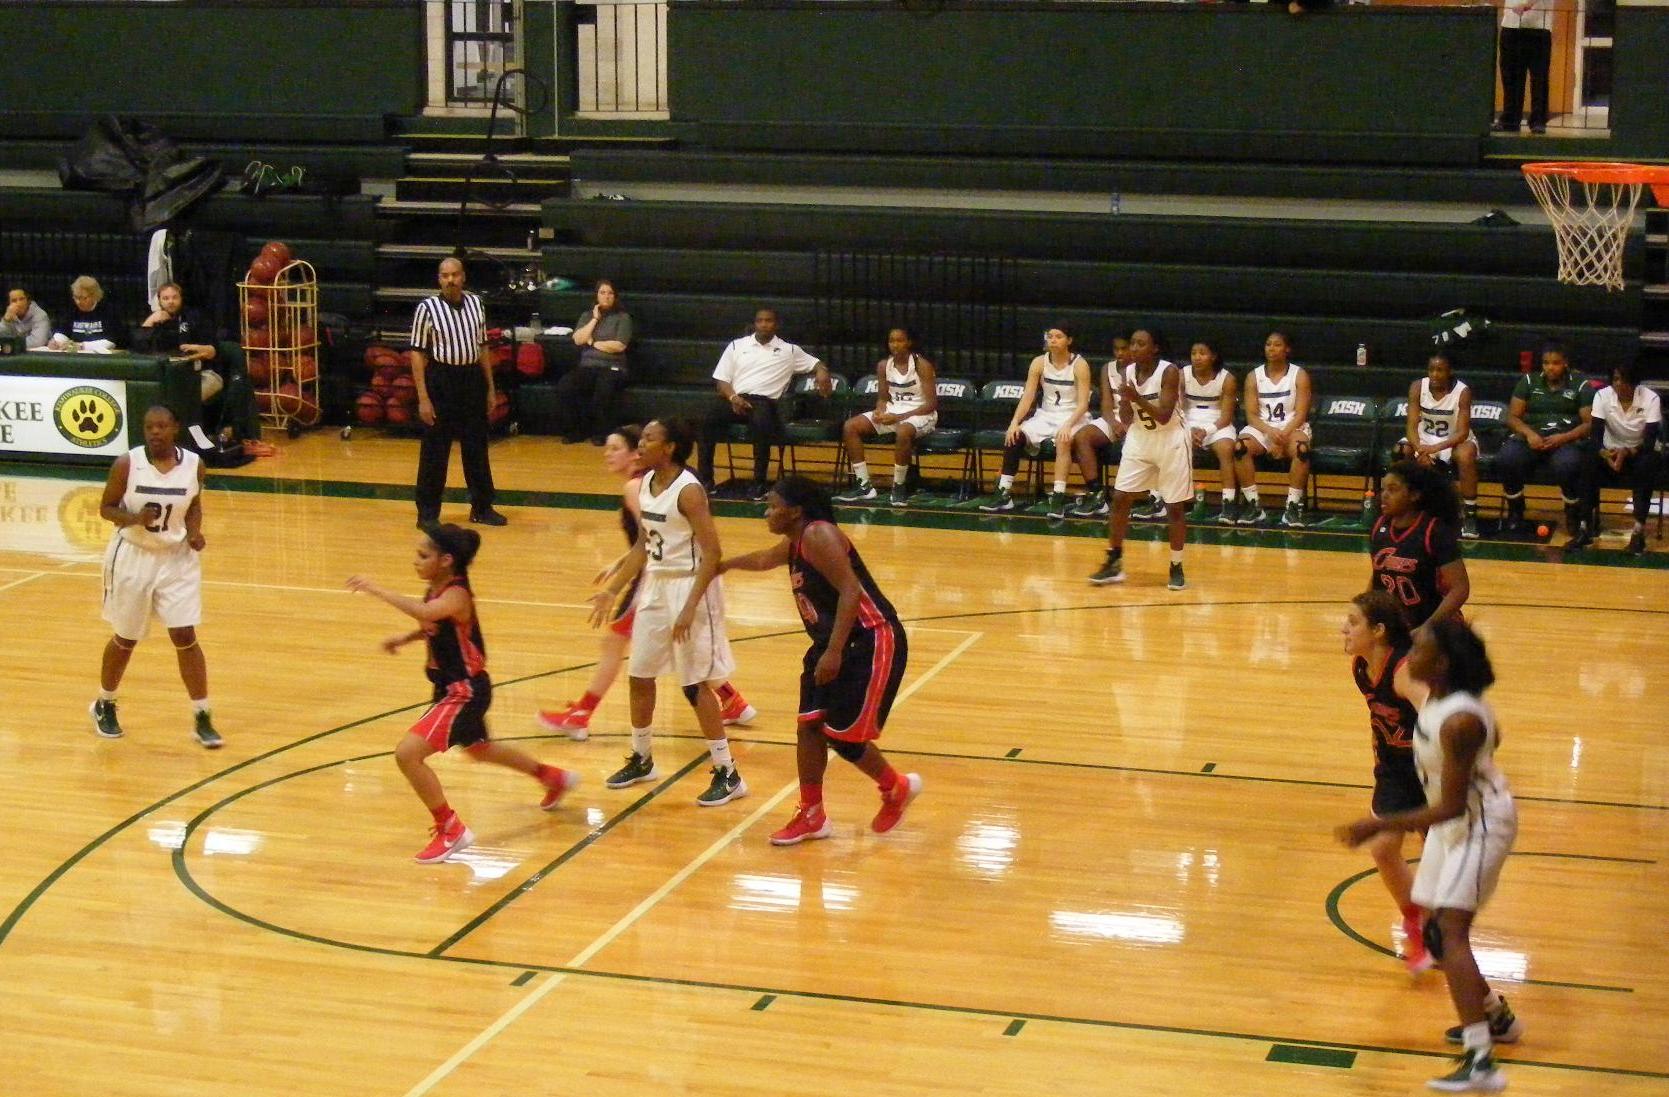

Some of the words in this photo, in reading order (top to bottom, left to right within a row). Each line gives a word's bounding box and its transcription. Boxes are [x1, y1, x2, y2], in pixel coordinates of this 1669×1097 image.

[1054, 390, 1062, 407] 1
[1328, 400, 1366, 416] KISH
[1137, 408, 1156, 430] 5
[1265, 402, 1285, 423] 14
[1423, 418, 1449, 437] 22
[143, 502, 173, 533] 21
